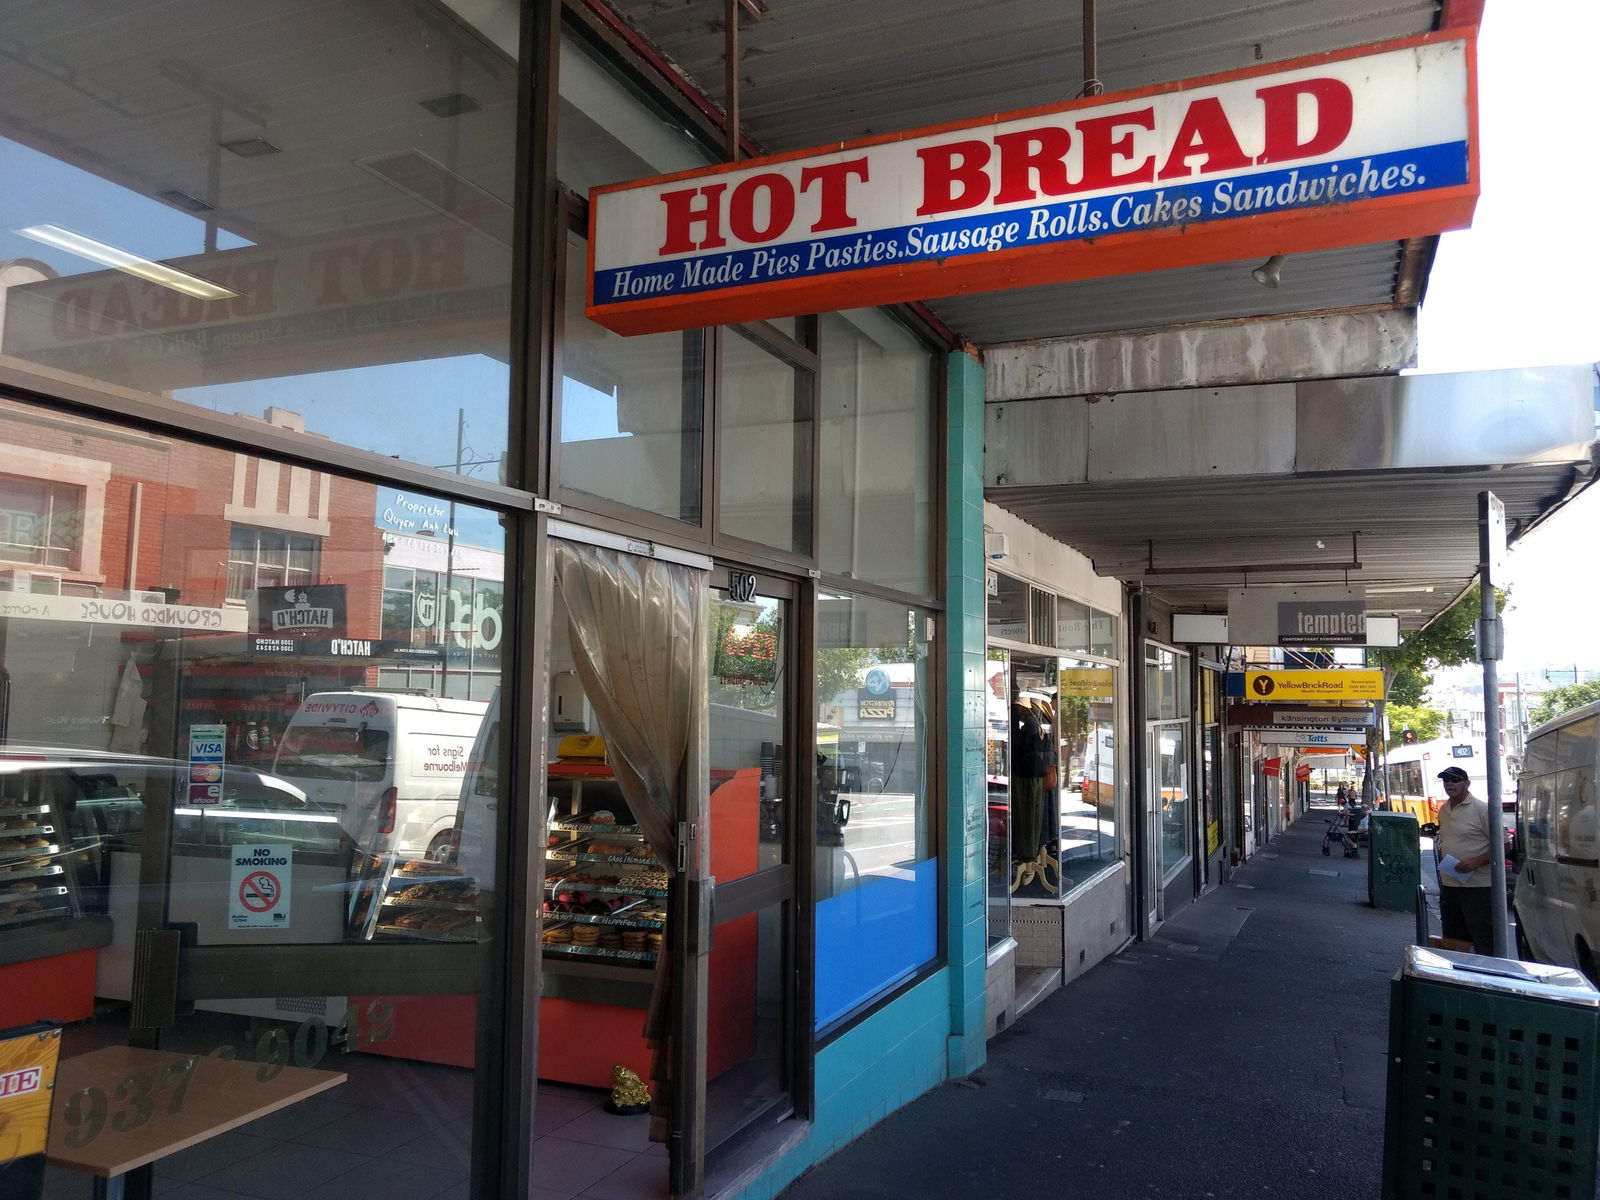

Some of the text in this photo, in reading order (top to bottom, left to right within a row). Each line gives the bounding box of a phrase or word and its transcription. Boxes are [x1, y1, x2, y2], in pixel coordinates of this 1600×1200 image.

[658, 77, 1354, 256] HOT BREAD
[612, 269, 675, 298] Home
[681, 255, 743, 290] Made
[749, 248, 801, 280] Pies
[1212, 159, 1427, 215] Sandwiches.
[396, 493, 445, 517] Proprietor
[731, 571, 757, 602] 502
[1297, 609, 1367, 635] tempted
[1278, 680, 1344, 689] YellowBrickRoad
[196, 743, 223, 754] VISA
[1307, 734, 1328, 743] Tatts
[235, 857, 288, 867] SMOKING
[253, 848, 271, 857] NO
[254, 999, 395, 1084] 9042
